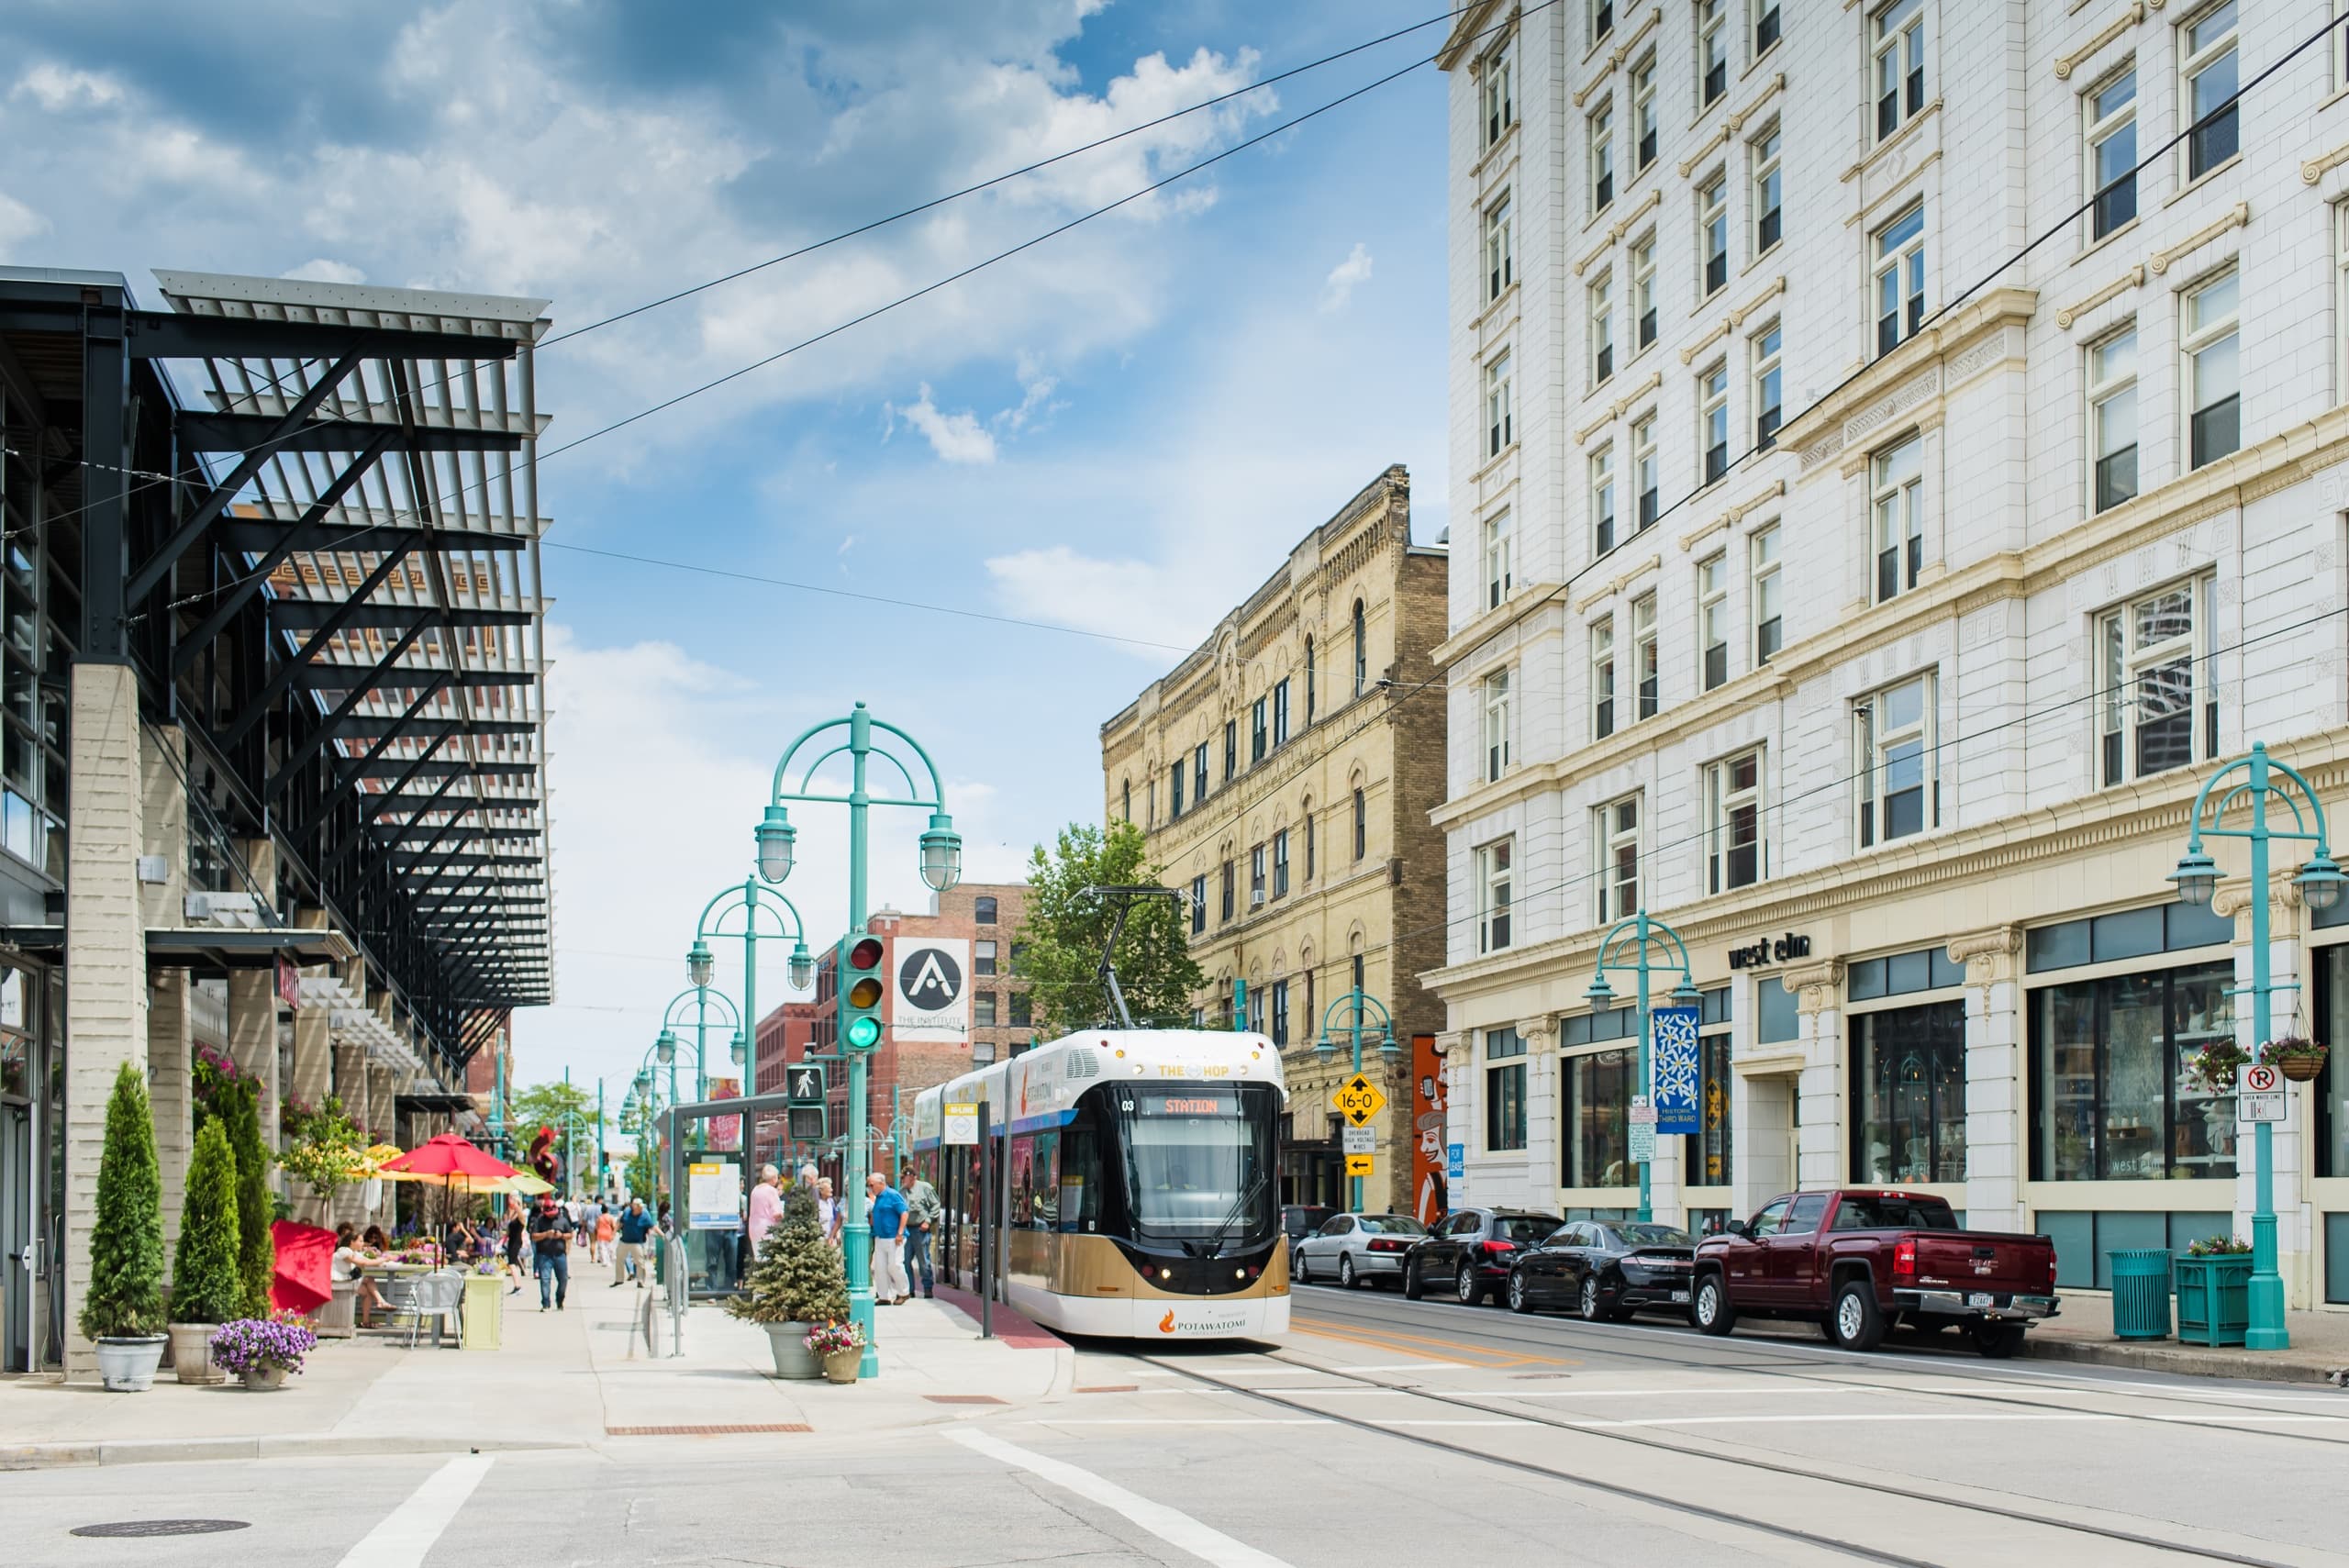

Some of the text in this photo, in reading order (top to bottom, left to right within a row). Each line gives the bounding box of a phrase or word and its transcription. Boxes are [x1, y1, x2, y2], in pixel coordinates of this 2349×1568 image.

[1728, 932, 1810, 970] west elm
[898, 1016, 962, 1024] THE INSTITUTE
[1159, 1065, 1229, 1077] THE HOP
[1122, 1100, 1134, 1111] 03
[1165, 1099, 1218, 1113] STATION
[1342, 1094, 1373, 1108] 16-0
[1451, 1149, 1460, 1159] FOR
[1450, 1162, 1463, 1172] LEASE
[2112, 1157, 2137, 1172] west
[1178, 1319, 1245, 1330] POTAWATOMI
